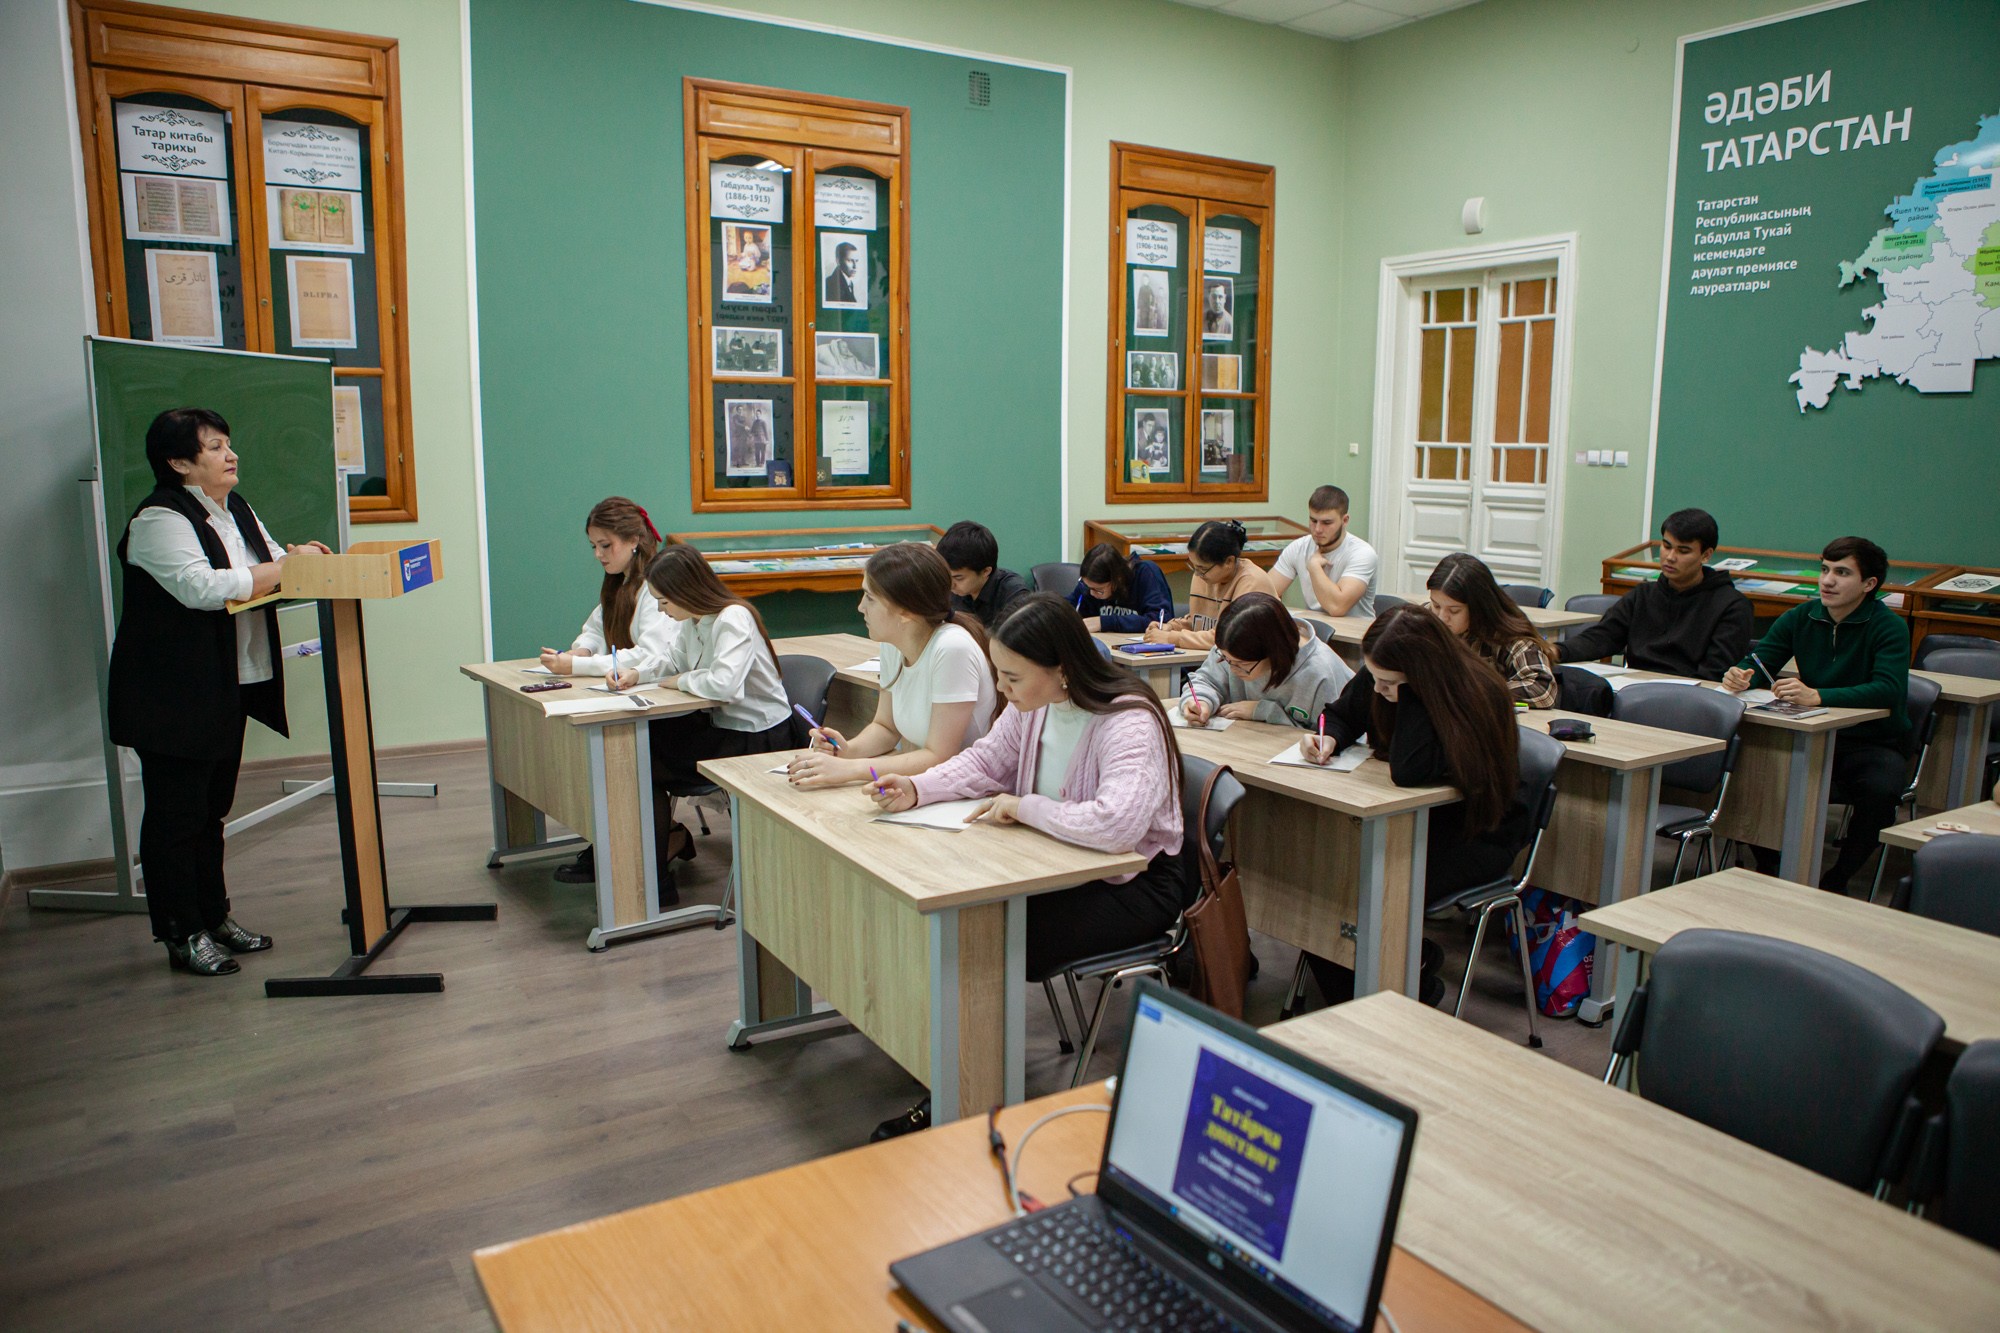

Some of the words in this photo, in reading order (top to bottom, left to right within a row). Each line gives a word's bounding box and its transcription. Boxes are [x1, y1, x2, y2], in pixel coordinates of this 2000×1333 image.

[1704, 69, 1832, 126] ӘДӘБИ
[132, 125, 166, 140] Татар
[170, 132, 213, 143] китабы
[1700, 106, 1912, 173] ТАТАРСТАН
[151, 141, 197, 153] тарихы
[720, 180, 753, 191] Габдулла
[755, 184, 774, 193] Тукай
[725, 192, 770, 204] (1886-1913)
[1696, 195, 1759, 212] Татарстан
[1695, 206, 1812, 228] Республикасының
[1907, 214, 1934, 223] районы
[1136, 233, 1150, 241] Муса
[1694, 230, 1750, 245] Габдулла
[1753, 223, 1792, 240] Тукай
[1136, 242, 1168, 252] (1906-1944)
[1693, 245, 1766, 262] исемендәге
[1897, 253, 1923, 261] районы
[1691, 265, 1734, 280] дәүләт
[1735, 260, 1798, 276] премиясе
[1689, 280, 1770, 297] лауреатлары
